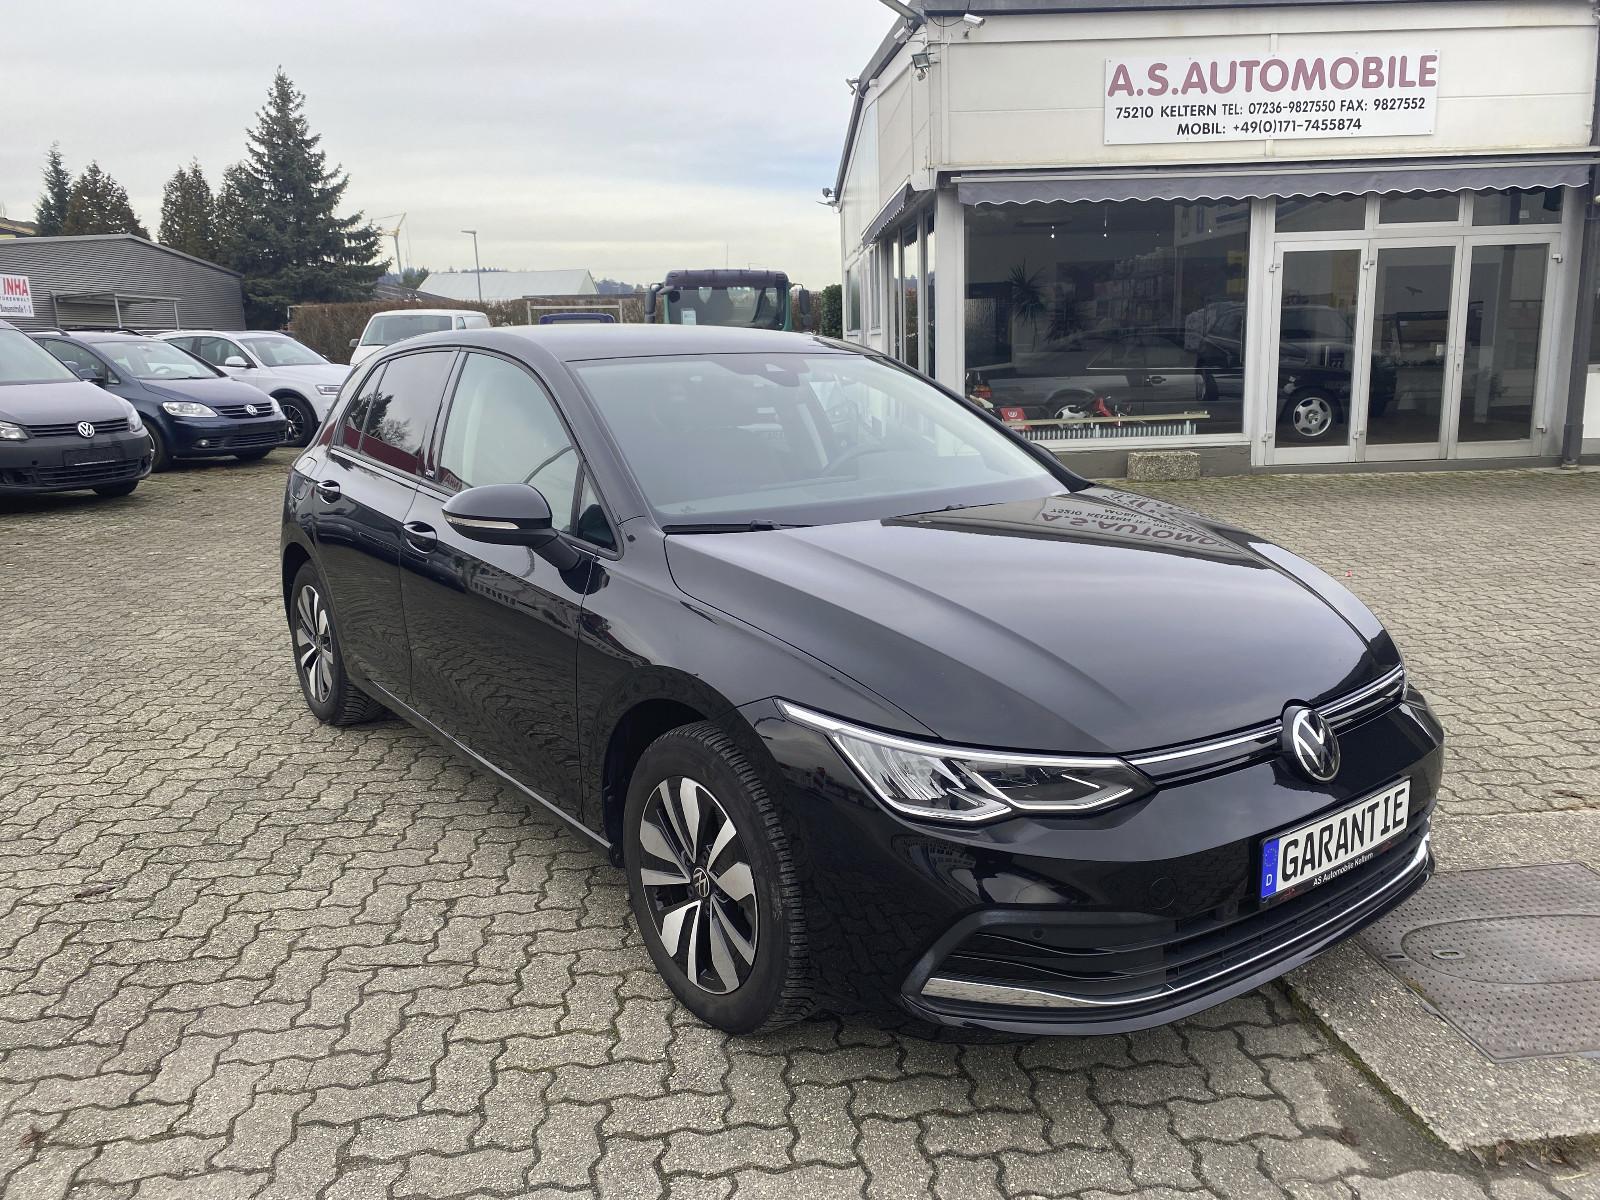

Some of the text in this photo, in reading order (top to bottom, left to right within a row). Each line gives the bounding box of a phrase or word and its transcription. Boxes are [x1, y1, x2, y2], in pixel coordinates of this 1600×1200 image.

[1107, 54, 1438, 97] A.S.AUTOMOBILE
[1115, 97, 1426, 120] 75210 KELTERN TEL: 07236-9827550 FAX: 9827552
[1176, 118, 1362, 136] MOBIL: +49(0)171-7455874
[3, 277, 28, 296] INHA
[1281, 787, 1406, 882] GARANTIE
[1265, 873, 1273, 887] D
[1313, 878, 1322, 887] AS
